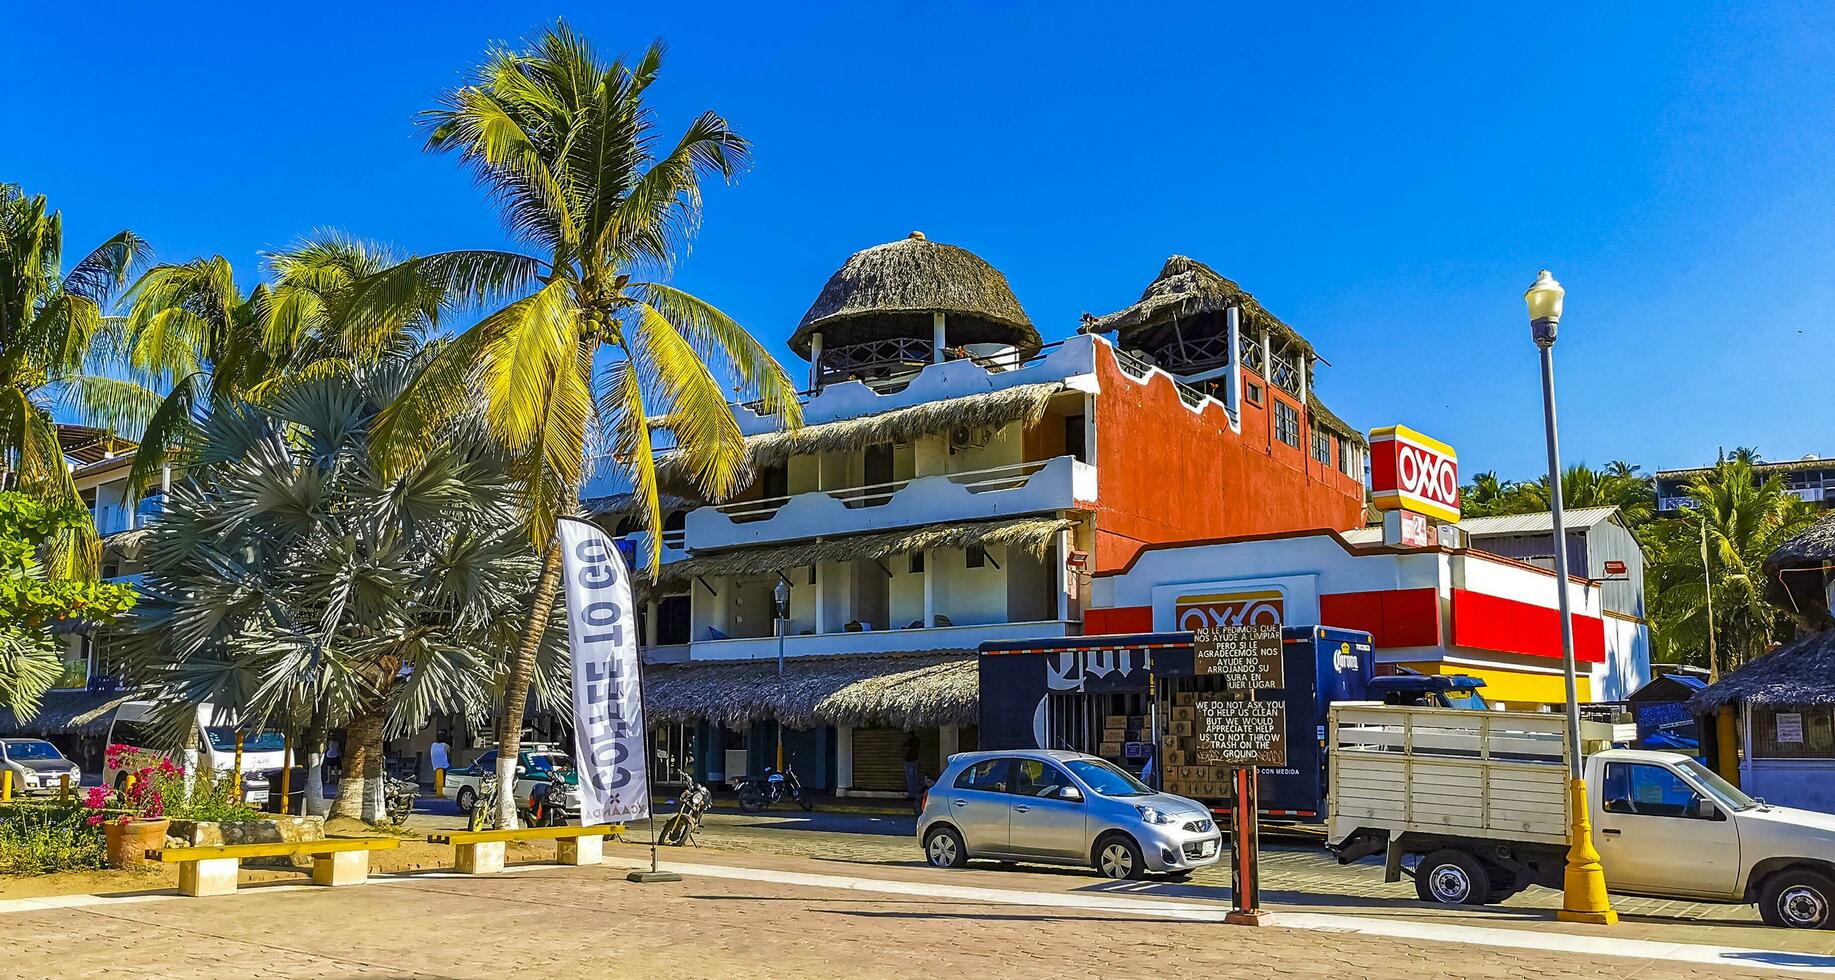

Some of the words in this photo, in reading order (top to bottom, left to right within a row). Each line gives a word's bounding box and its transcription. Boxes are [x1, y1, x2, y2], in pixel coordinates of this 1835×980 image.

[1400, 446, 1457, 504] OXXO
[1197, 627, 1208, 635] NO
[1223, 625, 1257, 633] PEDIMOS
[1261, 624, 1277, 632] QUE
[1194, 634, 1209, 642] NOS
[1213, 633, 1237, 641] AYUDE
[1250, 632, 1280, 640] LIMPIAR
[1216, 642, 1236, 650] PERO
[1240, 641, 1246, 649] SI
[1260, 648, 1278, 656] NOS
[1217, 658, 1243, 666] AYUDE
[1246, 657, 1258, 665] NO
[1207, 665, 1255, 673] ARROJANDO
[1258, 664, 1269, 672] SU
[1226, 673, 1248, 682] SURA
[1251, 673, 1261, 681] EN
[1248, 680, 1276, 688] LUGAR
[1195, 701, 1208, 709] WE
[1211, 701, 1223, 709] DO
[1226, 701, 1243, 709] NOT
[1247, 701, 1263, 709] ASK
[1266, 700, 1284, 709] YOU
[1203, 709, 1214, 717] TO
[1216, 709, 1235, 717] HELP
[1206, 717, 1222, 725] BUT
[1225, 717, 1239, 725] WE
[1242, 717, 1273, 725] WOULD
[1206, 725, 1252, 733] APPRECIATE
[1255, 725, 1274, 733] HELP
[1199, 733, 1211, 741] US
[1213, 733, 1225, 741] TO
[1227, 733, 1245, 741] NOT
[1249, 733, 1280, 742] THROW
[1210, 741, 1237, 749] TRASH
[1239, 741, 1252, 749] ON
[1255, 741, 1270, 749] THE
[1222, 750, 1258, 758] GROUND
